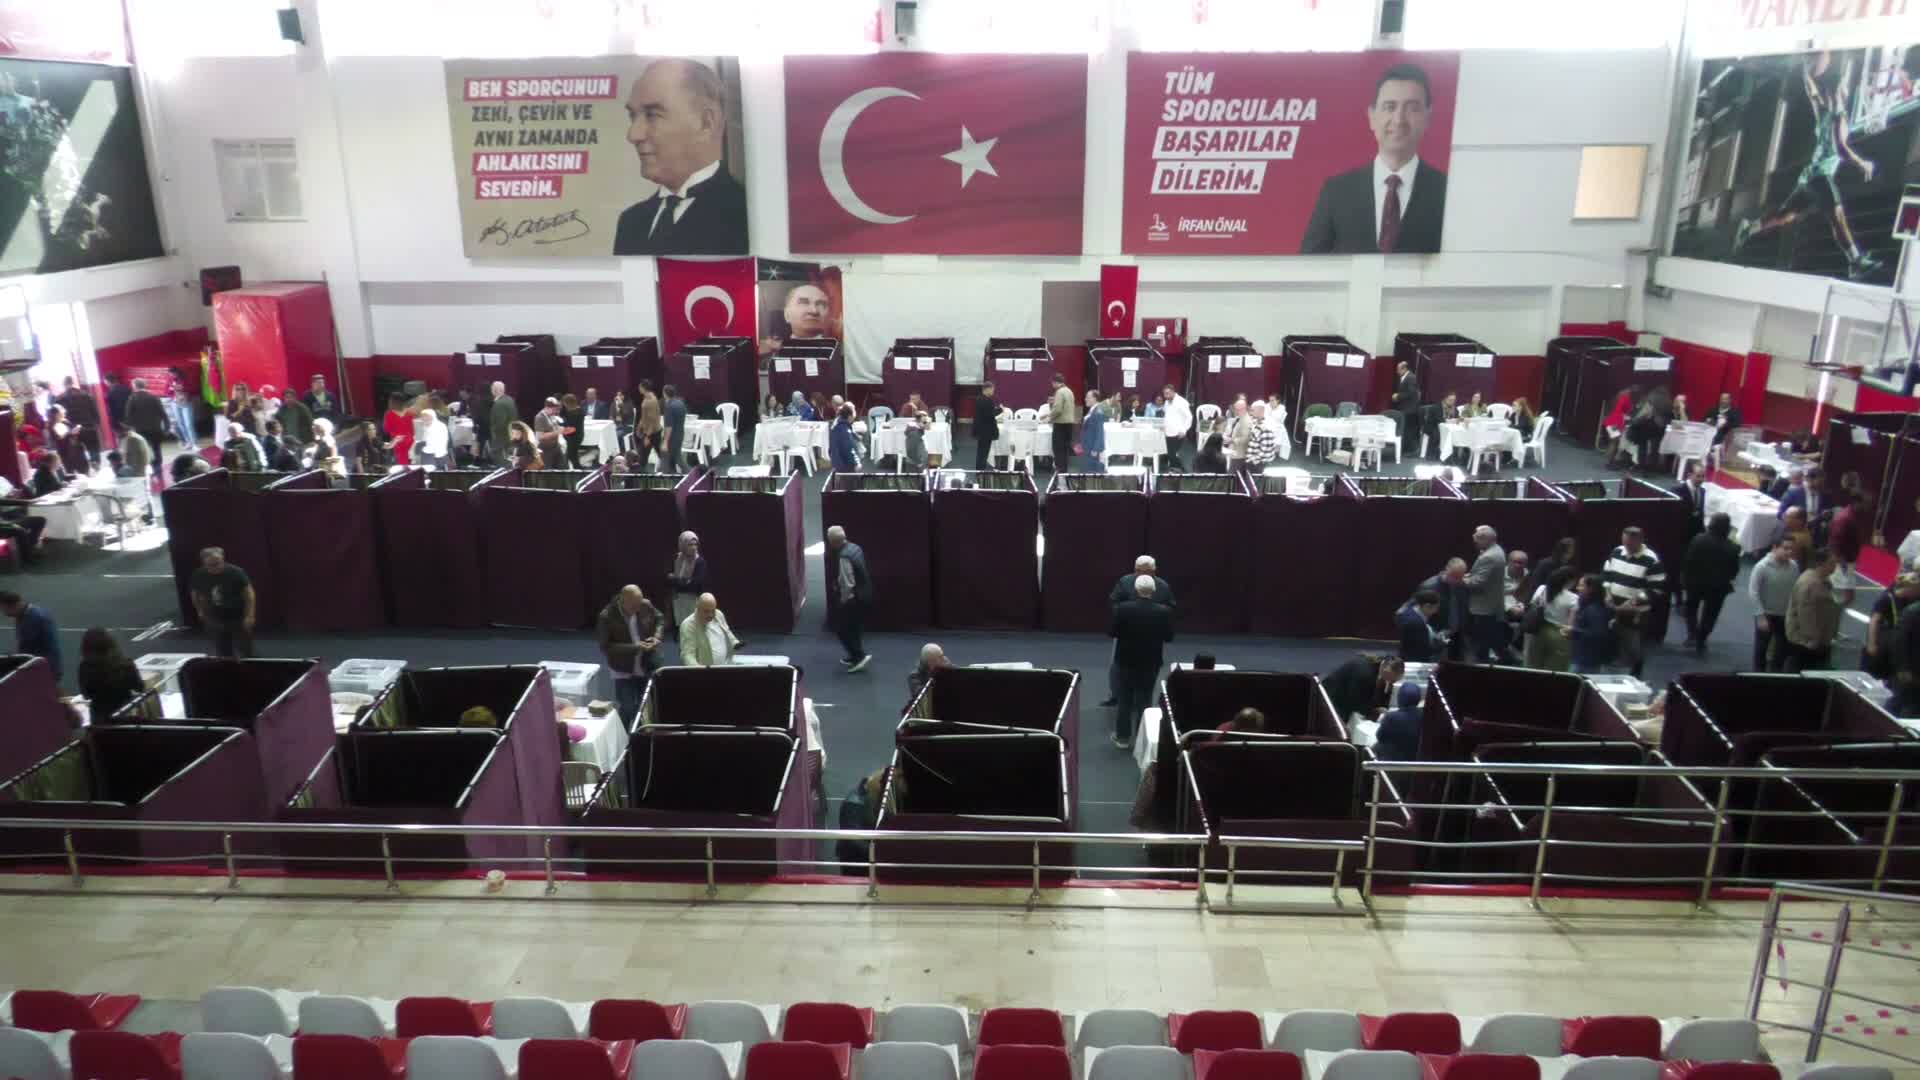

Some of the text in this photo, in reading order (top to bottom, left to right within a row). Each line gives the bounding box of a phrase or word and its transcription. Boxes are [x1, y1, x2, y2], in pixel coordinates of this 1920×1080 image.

[468, 78, 611, 98] BEN SPORCUNUN
[1164, 65, 1215, 95] TÜM
[472, 103, 593, 125] ZEKİ, ÇEVİK VE
[1162, 99, 1317, 122] SPORCULARA
[474, 128, 599, 147] AYNI ZAMANDA
[1160, 130, 1293, 157] BAŞARILAR
[476, 153, 582, 172] AHLAKLISINI
[480, 175, 558, 197] SEVERİM.
[1158, 161, 1260, 191] DİLERİM.
[1177, 216, 1248, 232] İRFAN ÖNAL
